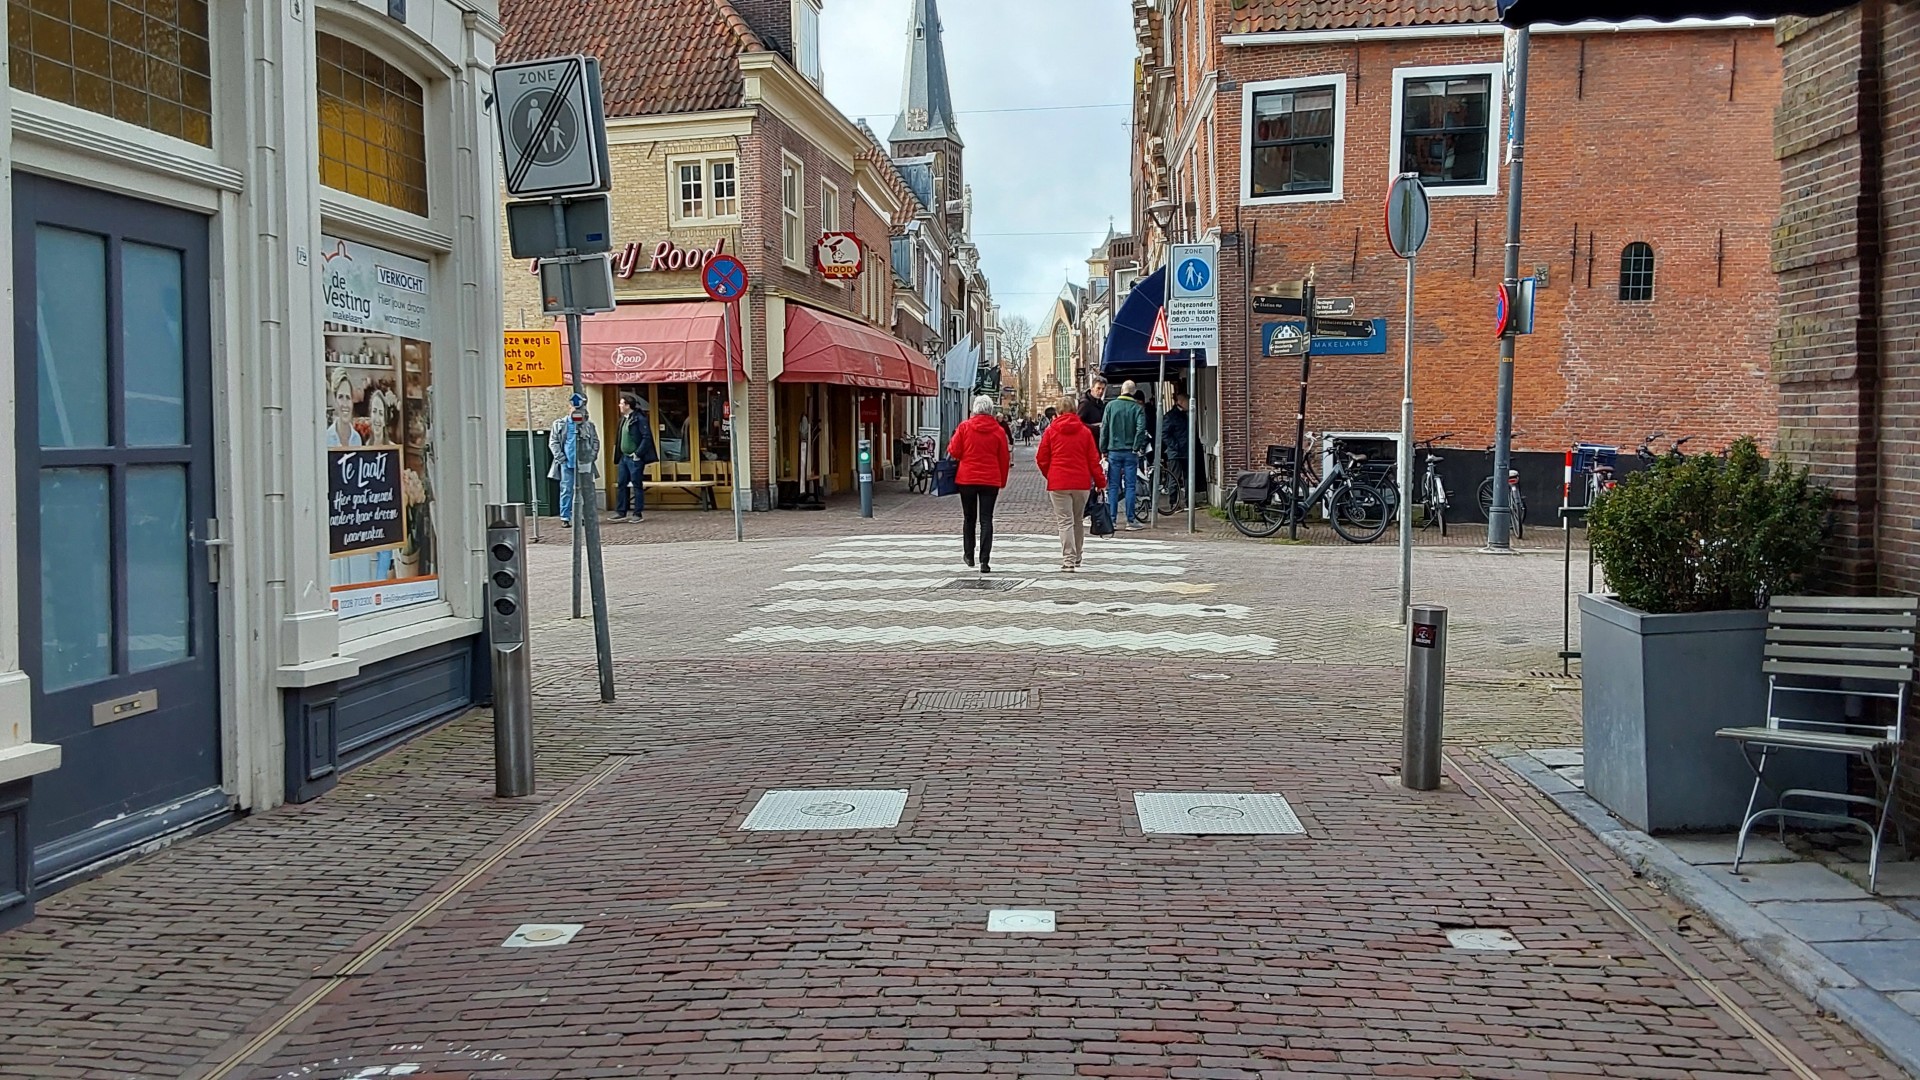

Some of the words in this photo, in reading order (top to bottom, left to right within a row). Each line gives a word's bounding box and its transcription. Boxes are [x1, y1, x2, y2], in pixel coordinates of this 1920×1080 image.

[518, 69, 557, 85] ZONE
[650, 238, 725, 271] Rood
[827, 265, 853, 273] ROOD
[332, 271, 346, 290] de
[380, 268, 424, 292] VERKOCHT
[323, 283, 371, 319] Vesting
[378, 293, 391, 306] Hier
[390, 297, 405, 311] jouw
[1174, 301, 1213, 309] uitgezonderd
[332, 311, 363, 325] makelaars
[384, 314, 421, 328] waarmaken?
[504, 337, 519, 345] eze
[523, 337, 541, 348] weg
[542, 336, 551, 345] is
[504, 349, 521, 358] icht
[524, 350, 535, 359] op
[516, 361, 523, 371] 2
[525, 361, 546, 371] mrt.
[517, 373, 533, 384] 16h
[615, 373, 642, 381] KOEK
[666, 371, 700, 381] GEBAK
[337, 452, 357, 483] Te
[358, 451, 389, 488] Laat!
[334, 489, 351, 511] Hier
[352, 488, 370, 508] gaat
[370, 487, 393, 504] iemand
[330, 511, 355, 527] anders
[355, 509, 373, 525] haar
